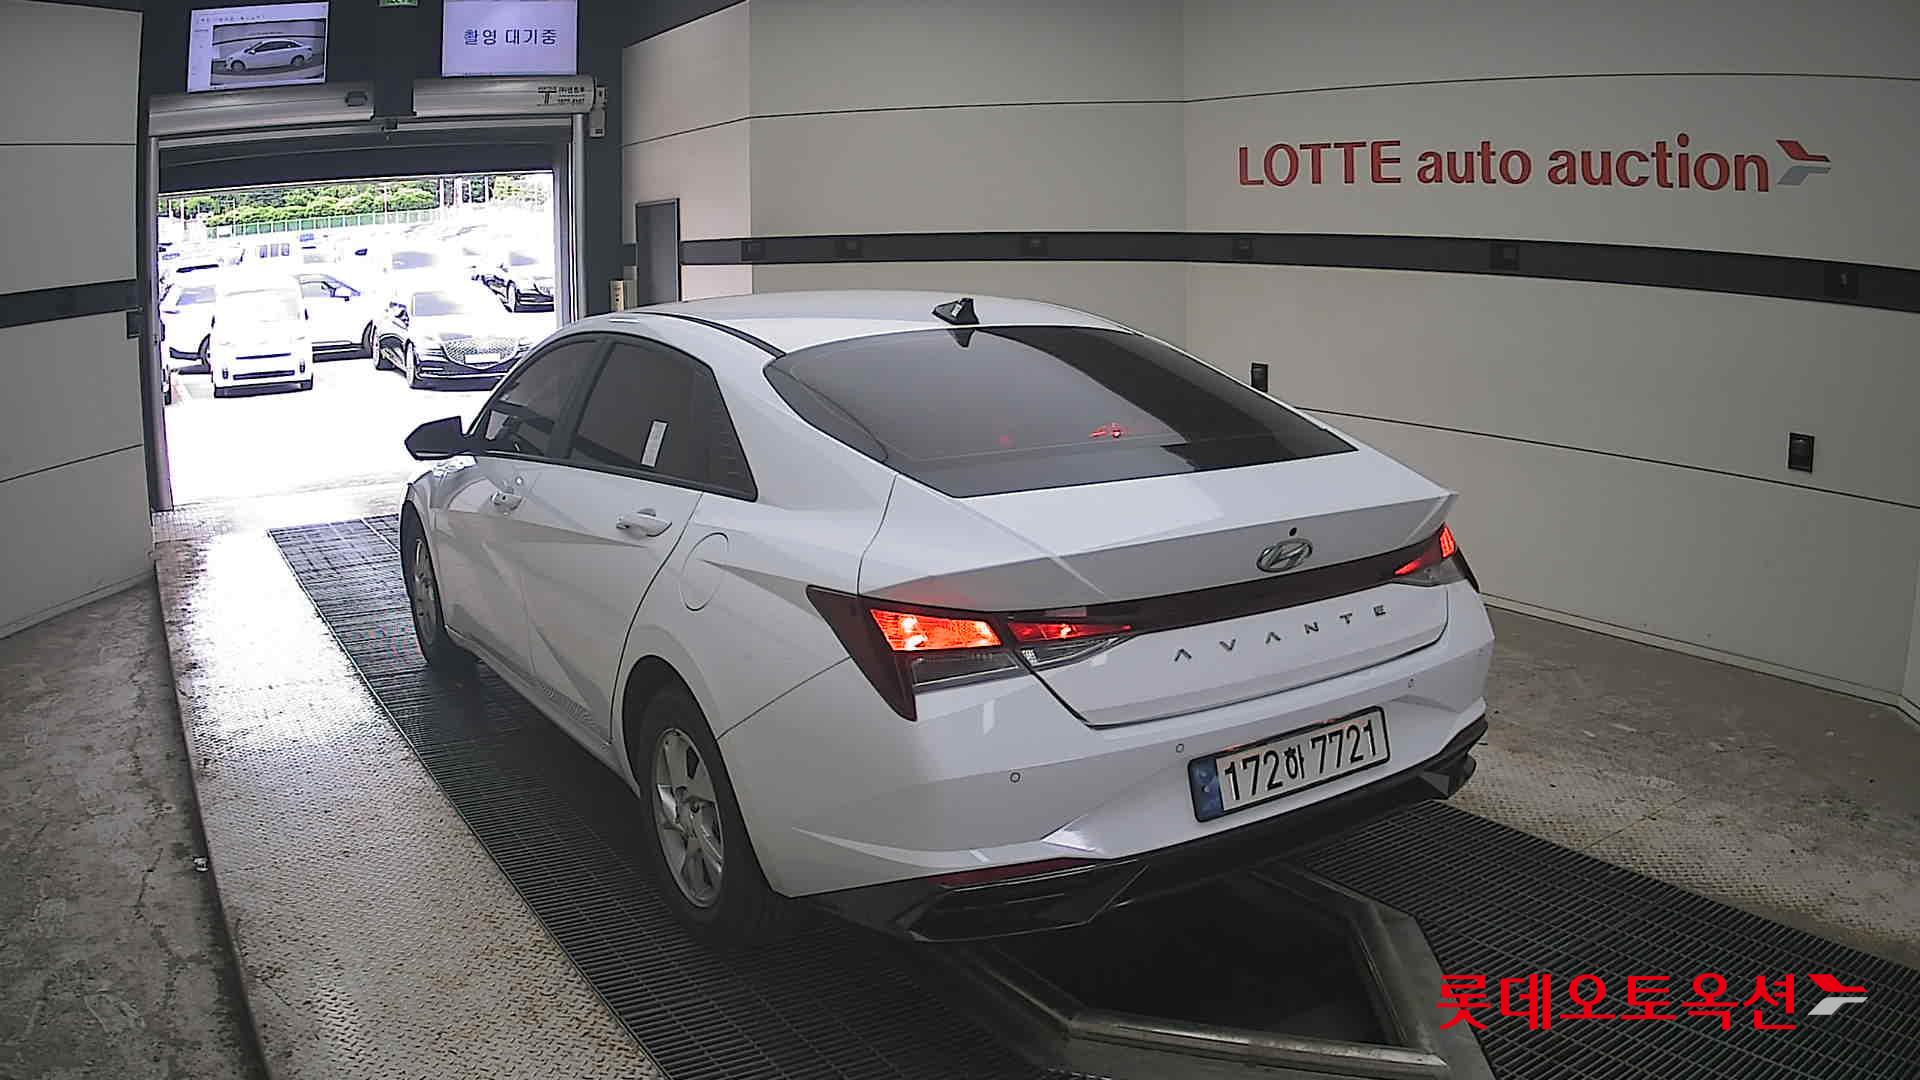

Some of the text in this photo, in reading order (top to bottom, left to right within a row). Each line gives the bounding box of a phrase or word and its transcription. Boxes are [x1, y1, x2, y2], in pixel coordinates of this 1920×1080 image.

[505, 29, 556, 45] 대기중
[1239, 133, 1770, 192] LOTTE auto auction
[1174, 604, 1386, 662] AVANTE
